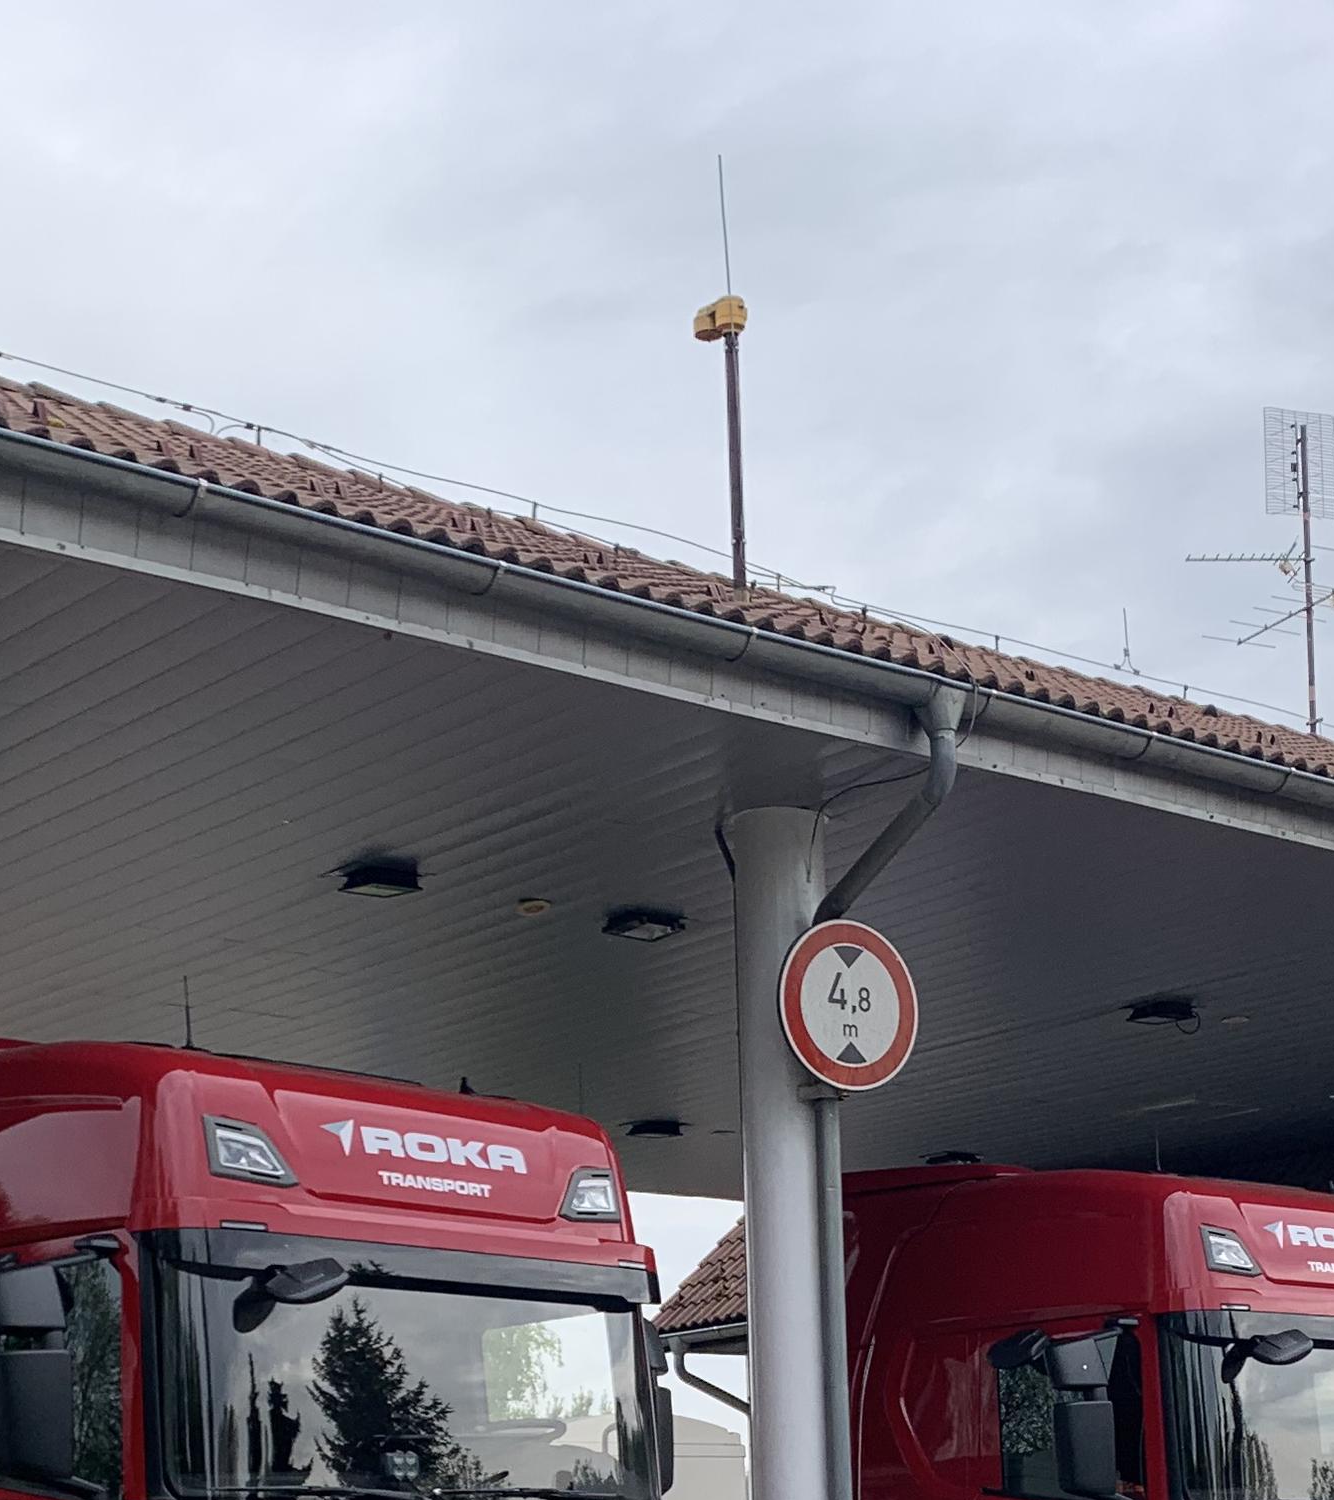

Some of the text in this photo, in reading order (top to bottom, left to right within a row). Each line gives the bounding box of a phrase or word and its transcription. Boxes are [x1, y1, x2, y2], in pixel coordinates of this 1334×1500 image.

[827, 972, 871, 1014] 4,8
[843, 1023, 858, 1037] m
[359, 1126, 528, 1175] ROKA
[378, 1171, 492, 1198] TRANSPORT
